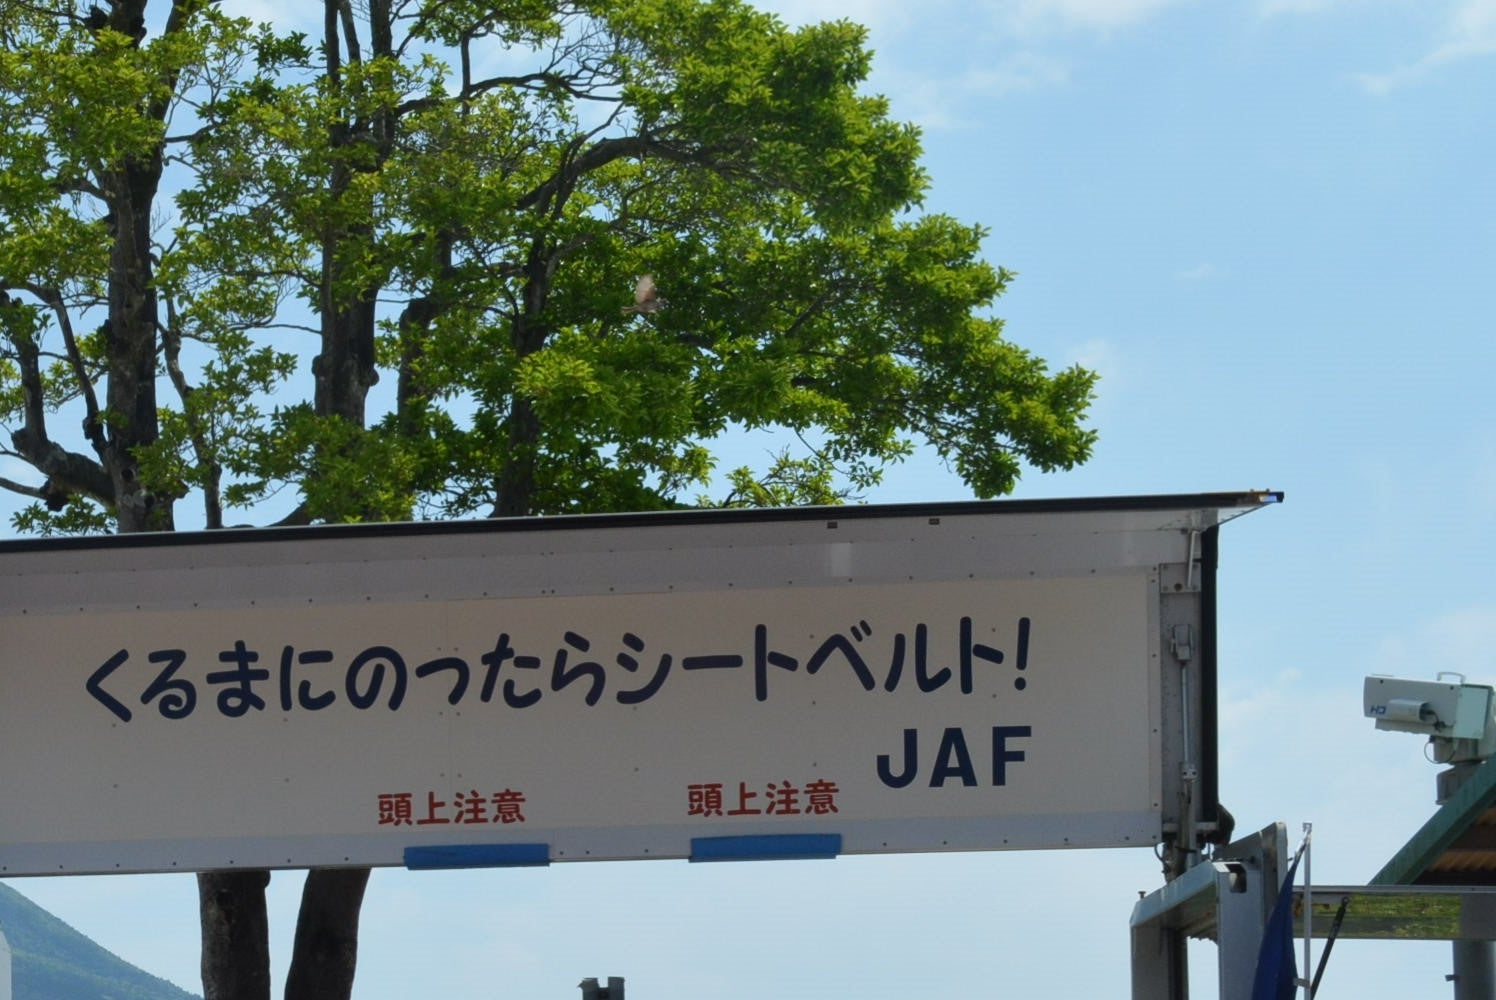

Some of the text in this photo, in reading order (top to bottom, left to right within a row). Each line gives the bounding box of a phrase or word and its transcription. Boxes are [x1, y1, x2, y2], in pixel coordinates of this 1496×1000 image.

[86, 617, 1031, 722] くるまにのったらシートベルト!
[876, 725, 1032, 789] JAF
[378, 789, 526, 827] 頭上注意
[687, 779, 840, 817] 頭上注意
